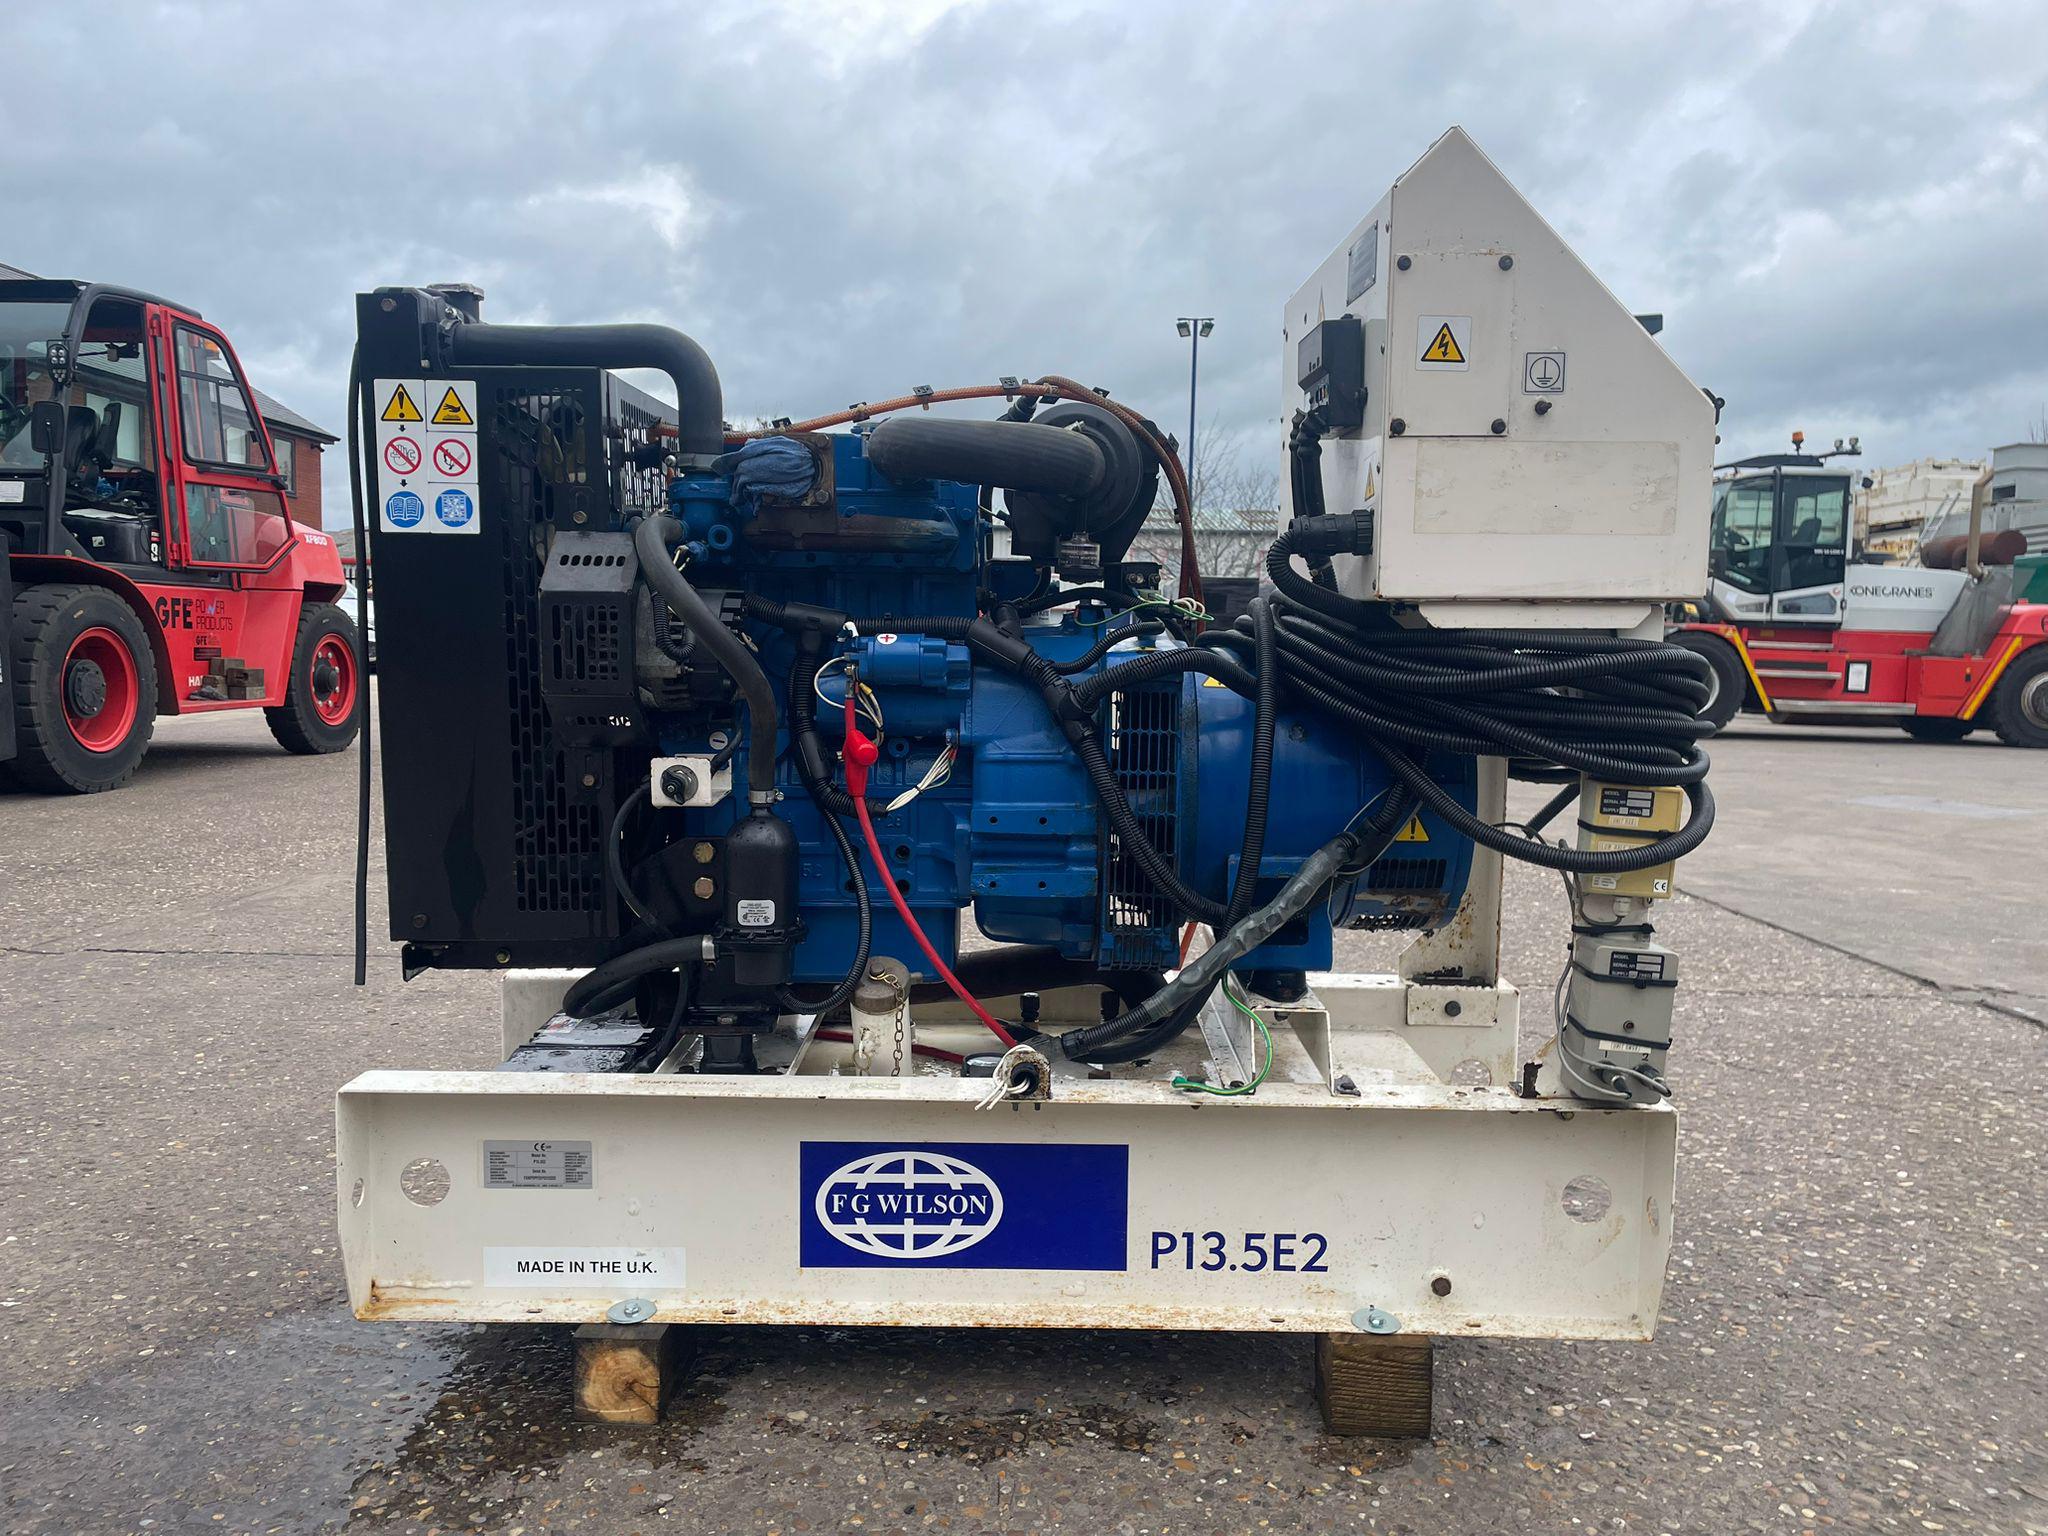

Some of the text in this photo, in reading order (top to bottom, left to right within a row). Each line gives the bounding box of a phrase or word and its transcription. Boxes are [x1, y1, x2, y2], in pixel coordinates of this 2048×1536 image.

[1850, 585, 1933, 599] KONECRANES
[155, 596, 193, 629] GFE
[195, 598, 225, 615] POWER
[196, 615, 233, 632] PRODUCTS
[831, 1193, 988, 1215] FG WILSON
[1150, 1230, 1329, 1273] P13.5E2
[517, 1261, 658, 1274] MADE IN THE U.K.
